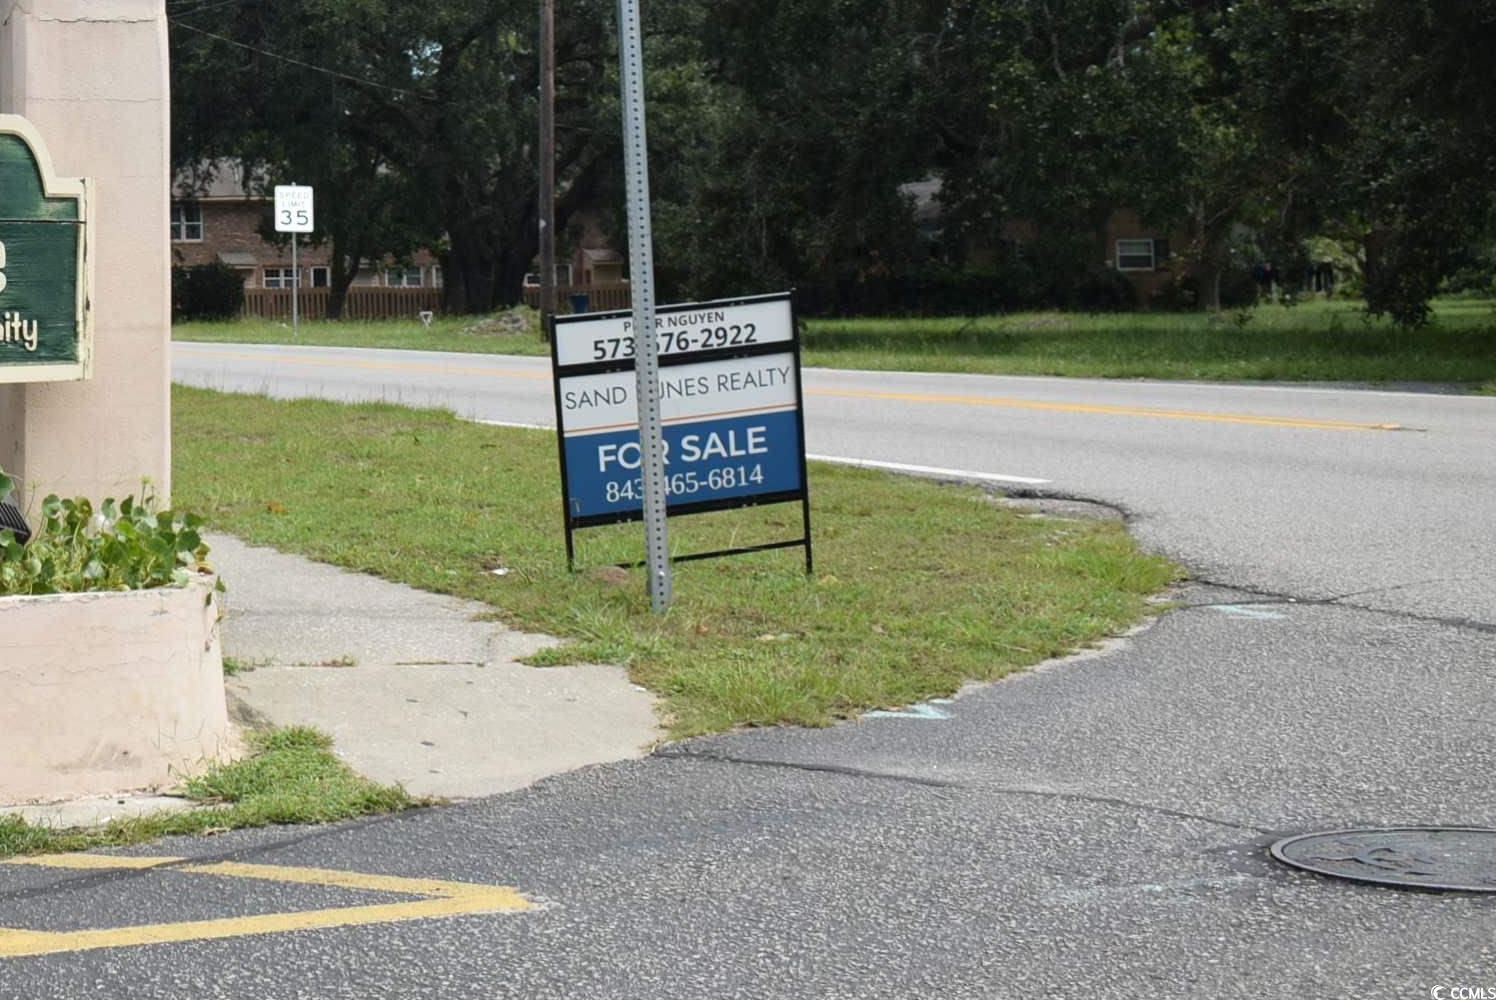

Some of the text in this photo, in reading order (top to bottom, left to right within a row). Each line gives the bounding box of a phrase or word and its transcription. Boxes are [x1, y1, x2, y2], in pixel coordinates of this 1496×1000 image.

[280, 209, 309, 226] 35
[667, 311, 725, 328] NGUYEN
[593, 323, 757, 361] 57376-2922
[565, 386, 627, 410] SAND
[717, 366, 791, 393] REALTY
[680, 426, 769, 462] SALE
